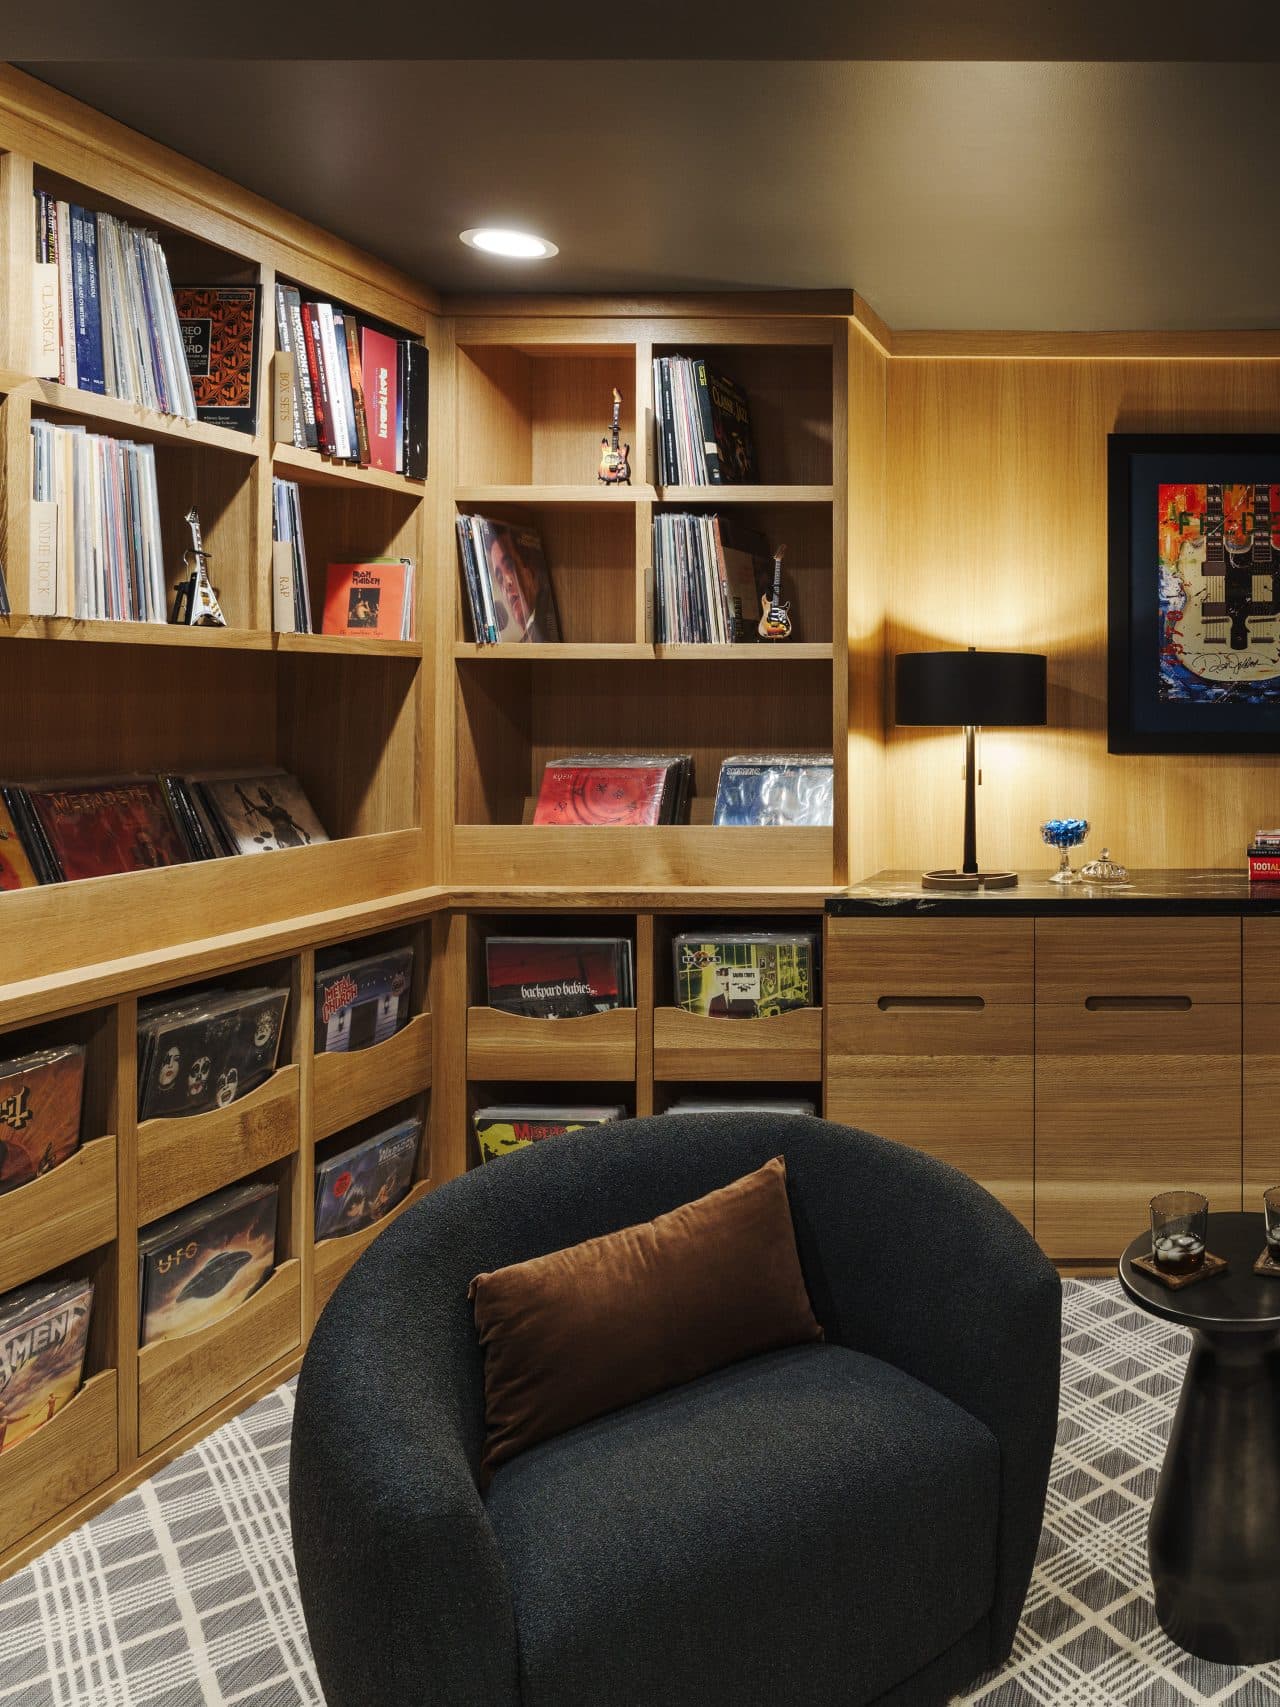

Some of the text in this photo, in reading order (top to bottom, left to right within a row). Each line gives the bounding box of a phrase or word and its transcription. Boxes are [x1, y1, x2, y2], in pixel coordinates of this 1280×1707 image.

[42, 285, 55, 353] CLASSICAL
[279, 372, 290, 422] BOX SETS
[304, 390, 315, 425] SOUND
[39, 521, 51, 595] INDIE ROCK
[278, 575, 290, 600] RAP
[352, 577, 381, 585] MAIDEN
[1253, 862, 1270, 871] 1001
[322, 983, 358, 1024] CHURCH
[521, 983, 562, 1000] backyard
[562, 981, 591, 996] babies
[155, 1241, 199, 1275] UFO
